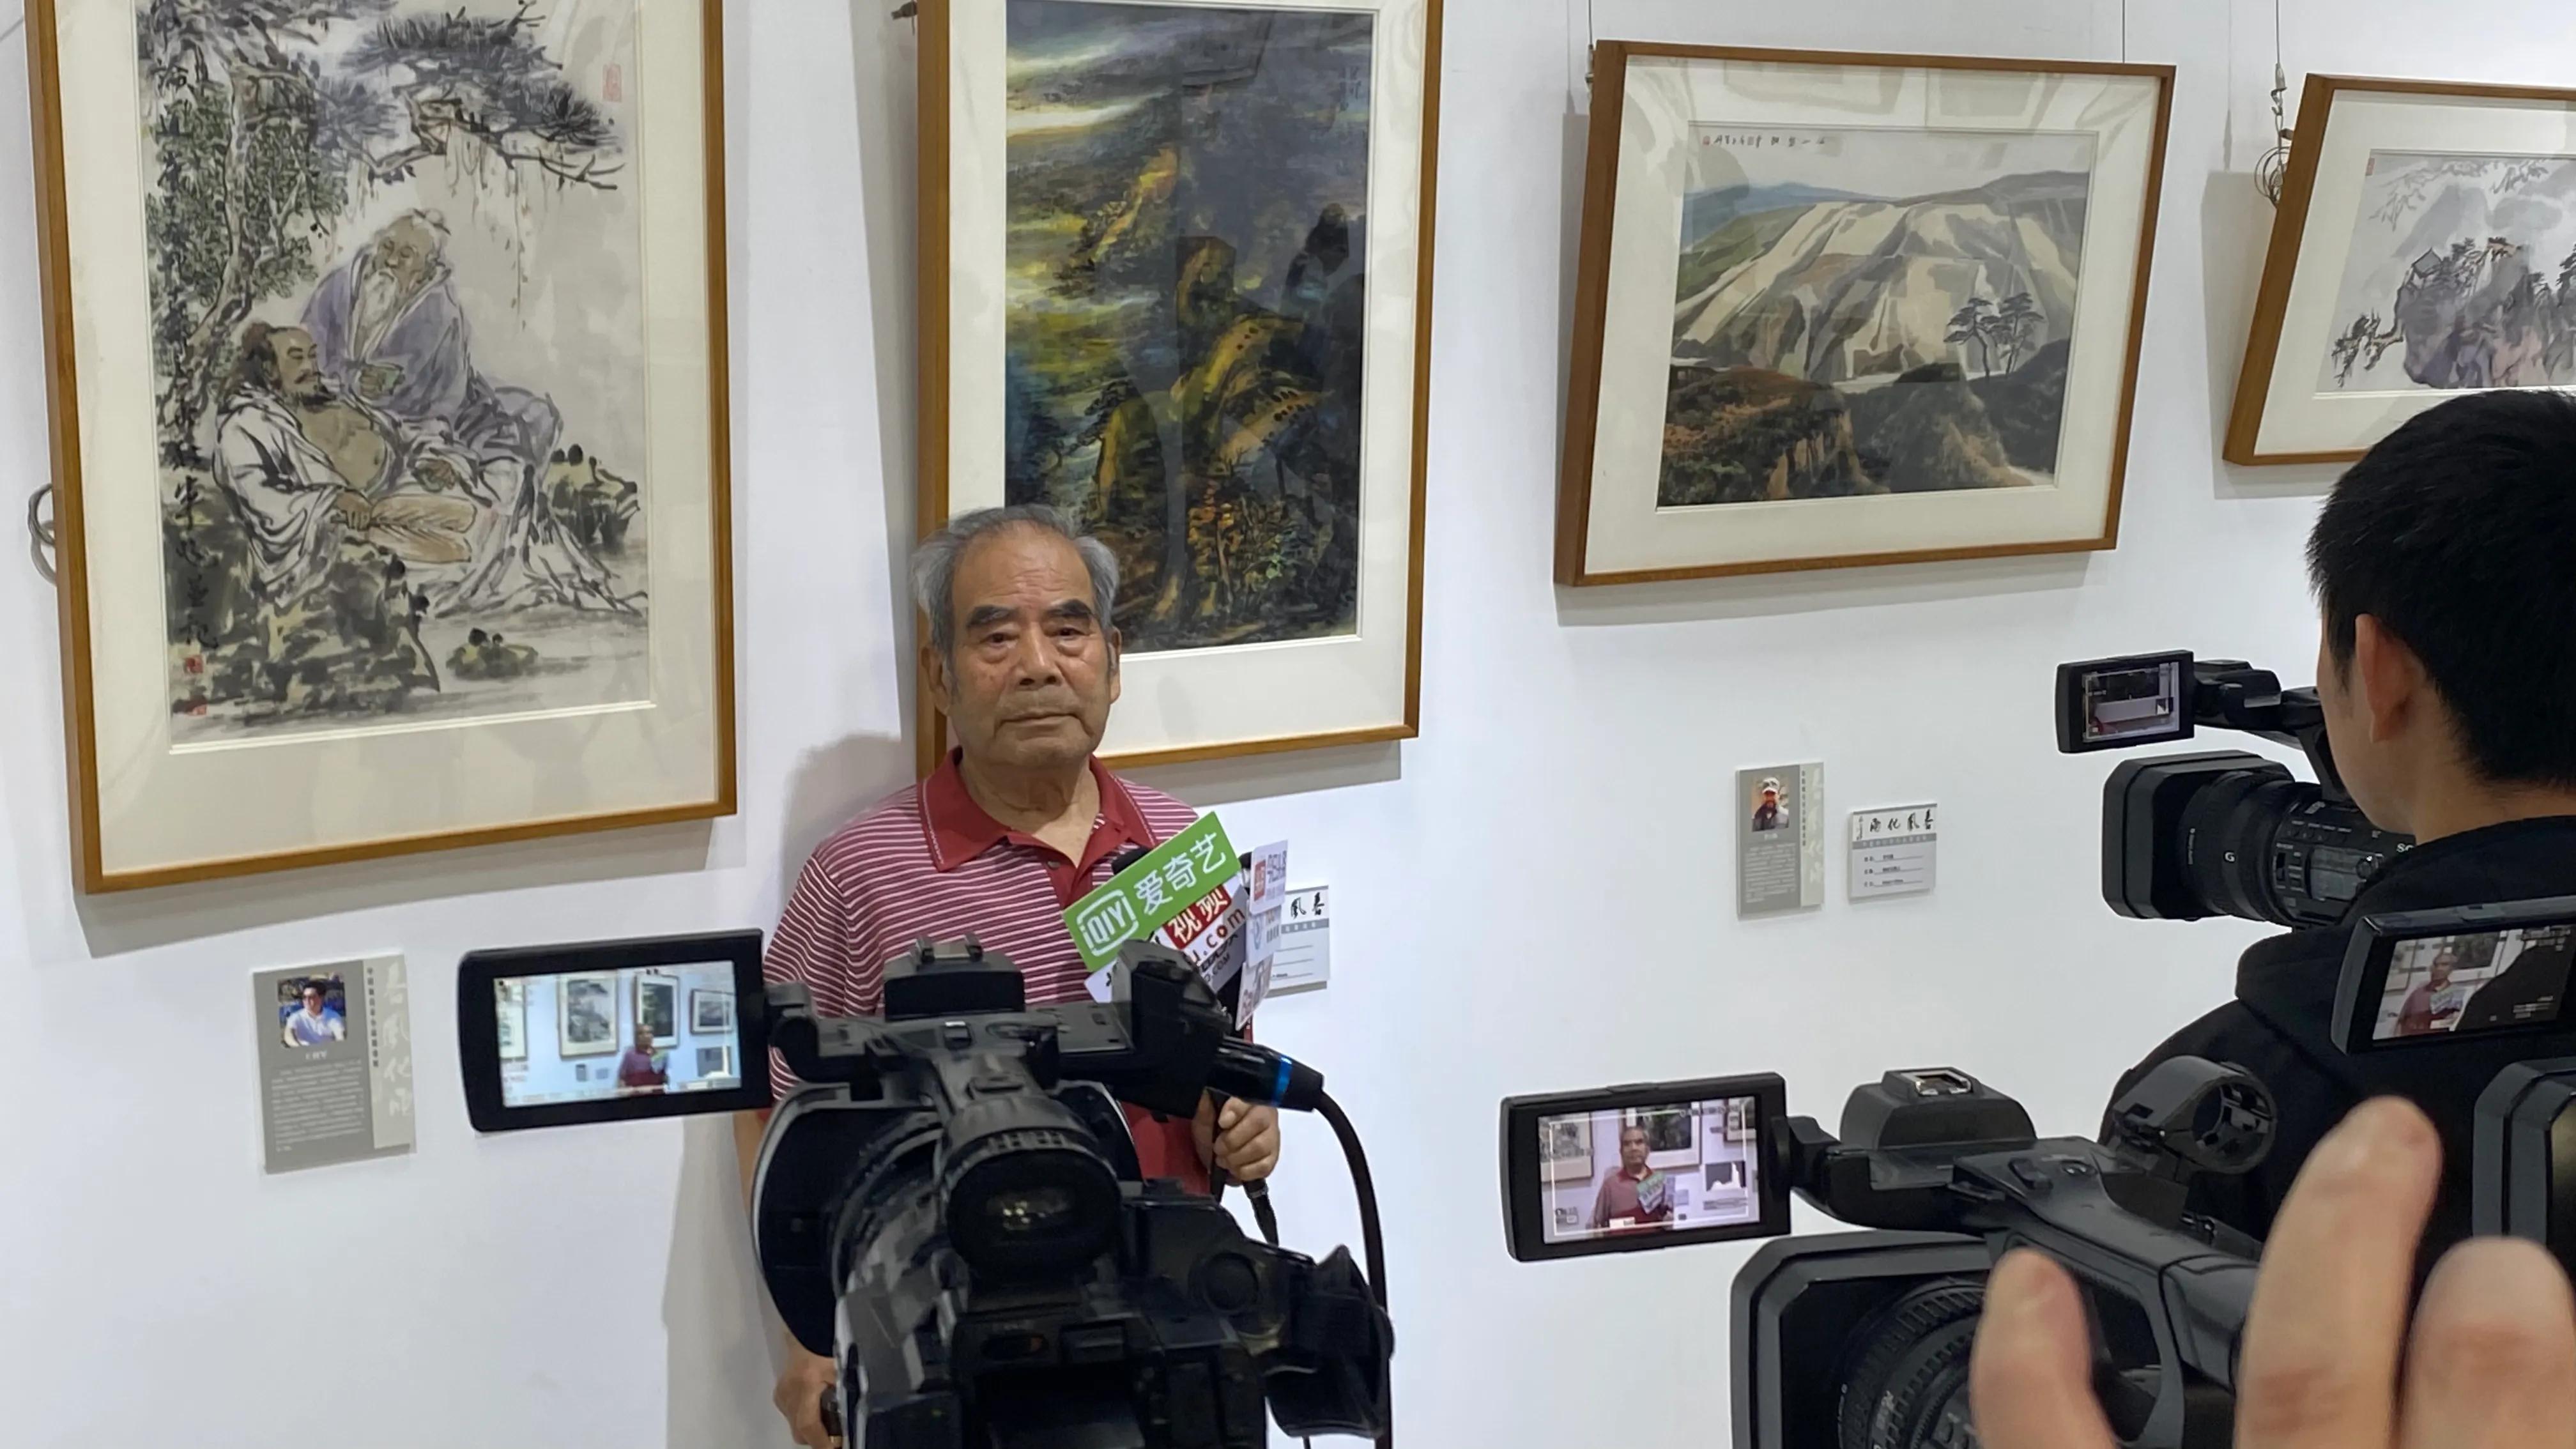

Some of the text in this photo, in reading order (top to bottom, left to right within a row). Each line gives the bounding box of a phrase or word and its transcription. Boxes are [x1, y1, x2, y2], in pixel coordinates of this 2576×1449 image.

[1134, 831, 1227, 916] 爱奇艺
[2224, 851, 2235, 862] G
[1168, 887, 1228, 944] 视频
